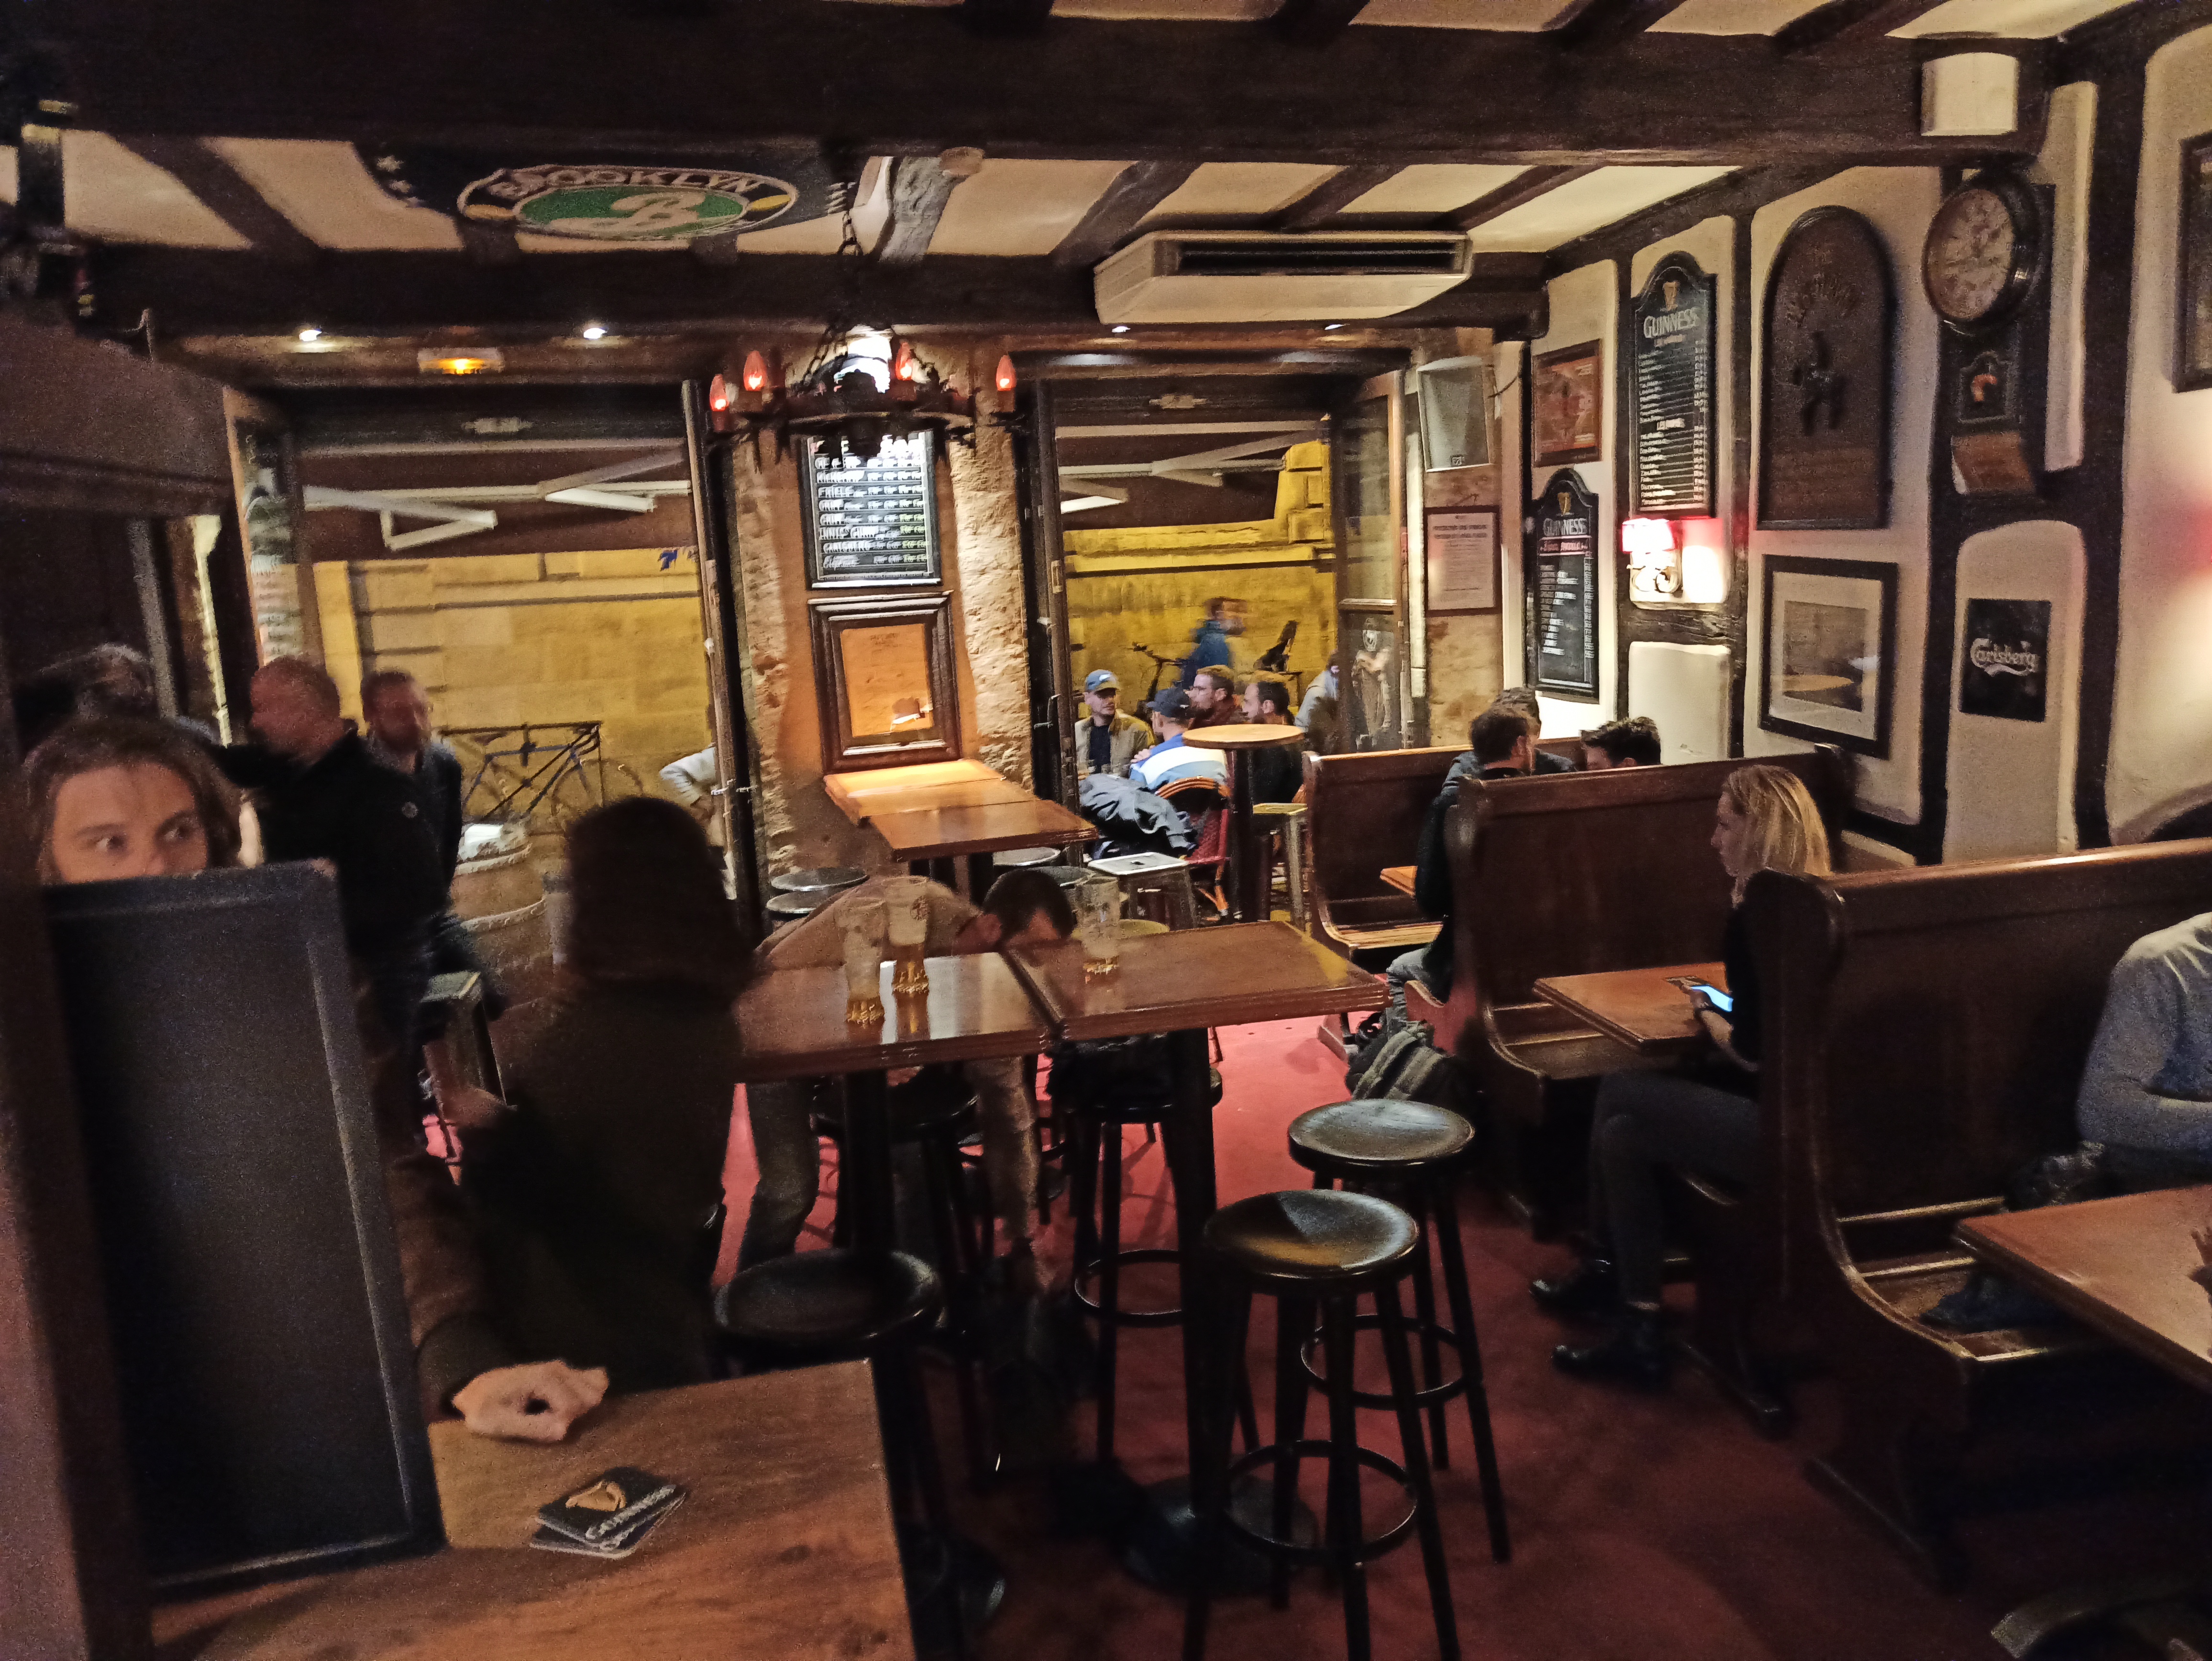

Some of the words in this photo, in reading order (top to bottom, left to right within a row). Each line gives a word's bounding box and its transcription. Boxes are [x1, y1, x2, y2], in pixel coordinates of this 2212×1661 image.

[1643, 308, 1699, 338] GUINNESS
[1543, 518, 1587, 536] GUINNESS
[1970, 638, 2040, 675] Carlsberg
